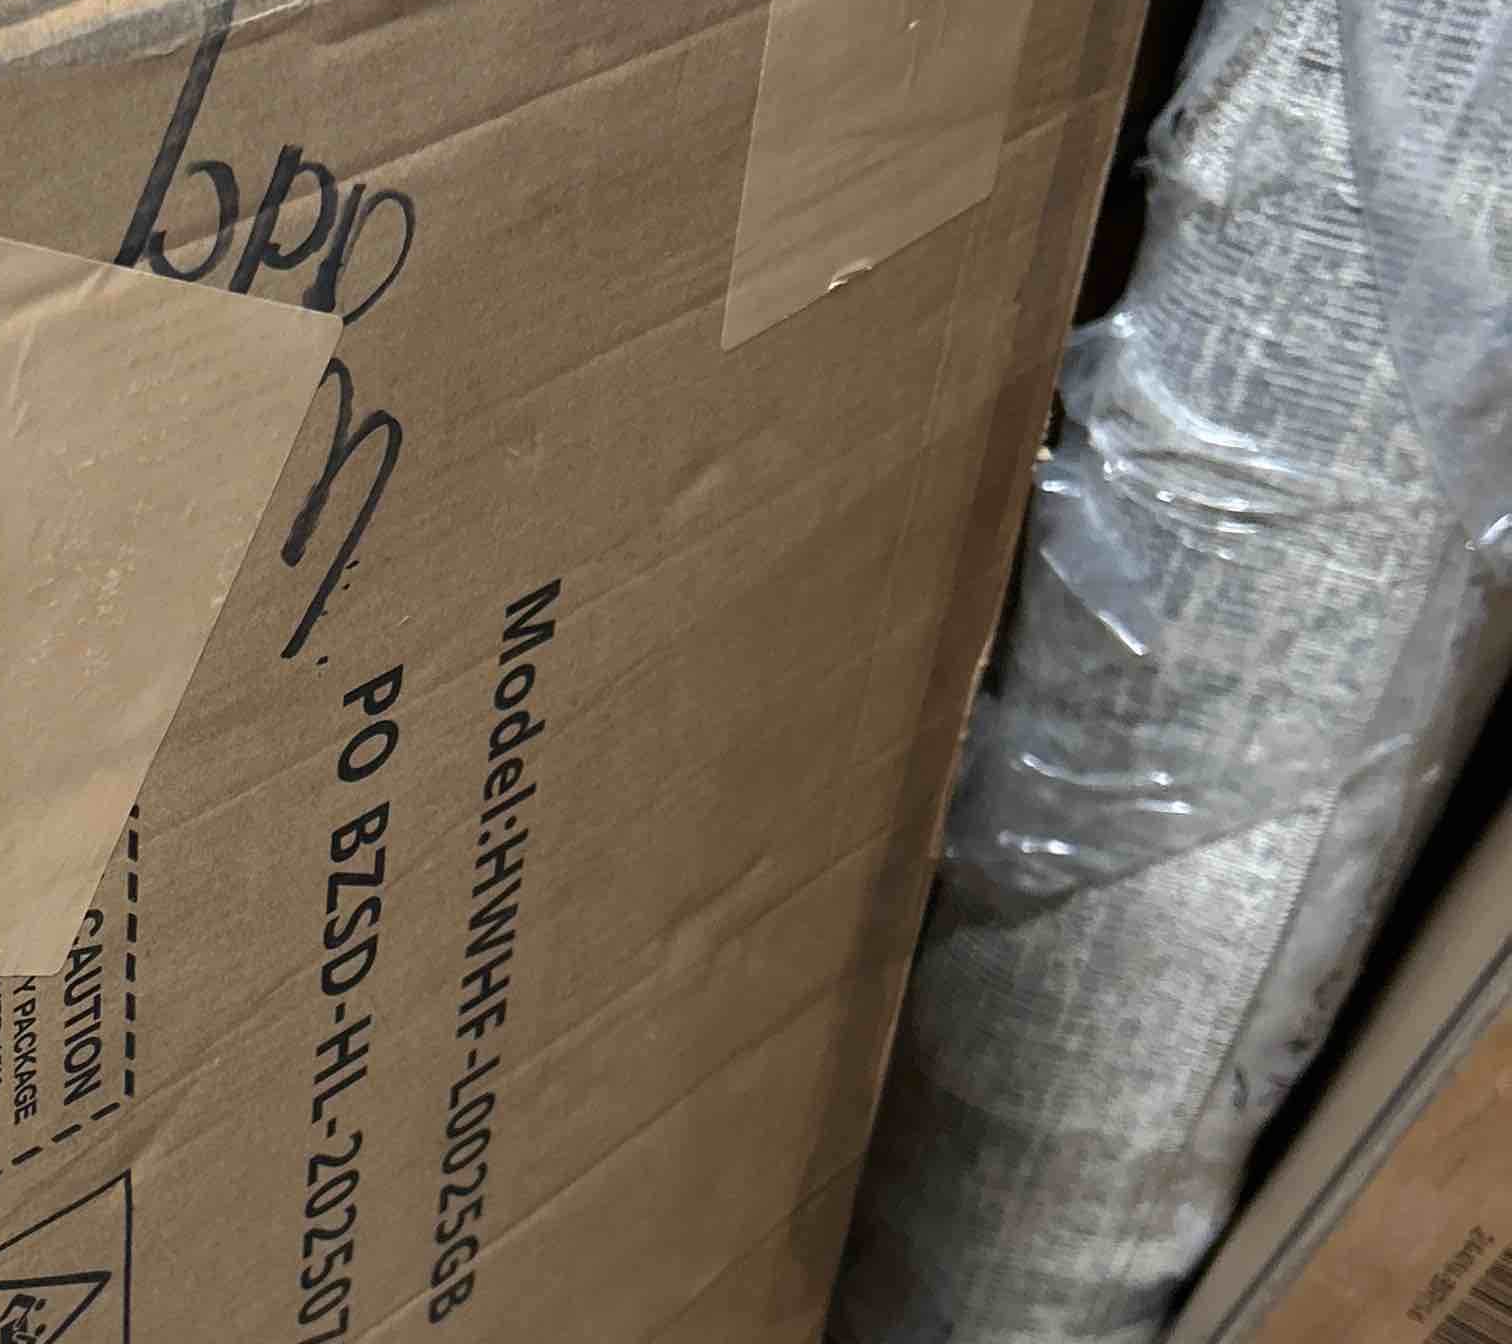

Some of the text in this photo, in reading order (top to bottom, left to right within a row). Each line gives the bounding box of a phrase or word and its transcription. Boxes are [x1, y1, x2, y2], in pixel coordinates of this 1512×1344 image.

[335, 663, 405, 785] PO
[13, 998, 38, 1126] PACKAGE
[63, 908, 104, 1106] CAUTION
